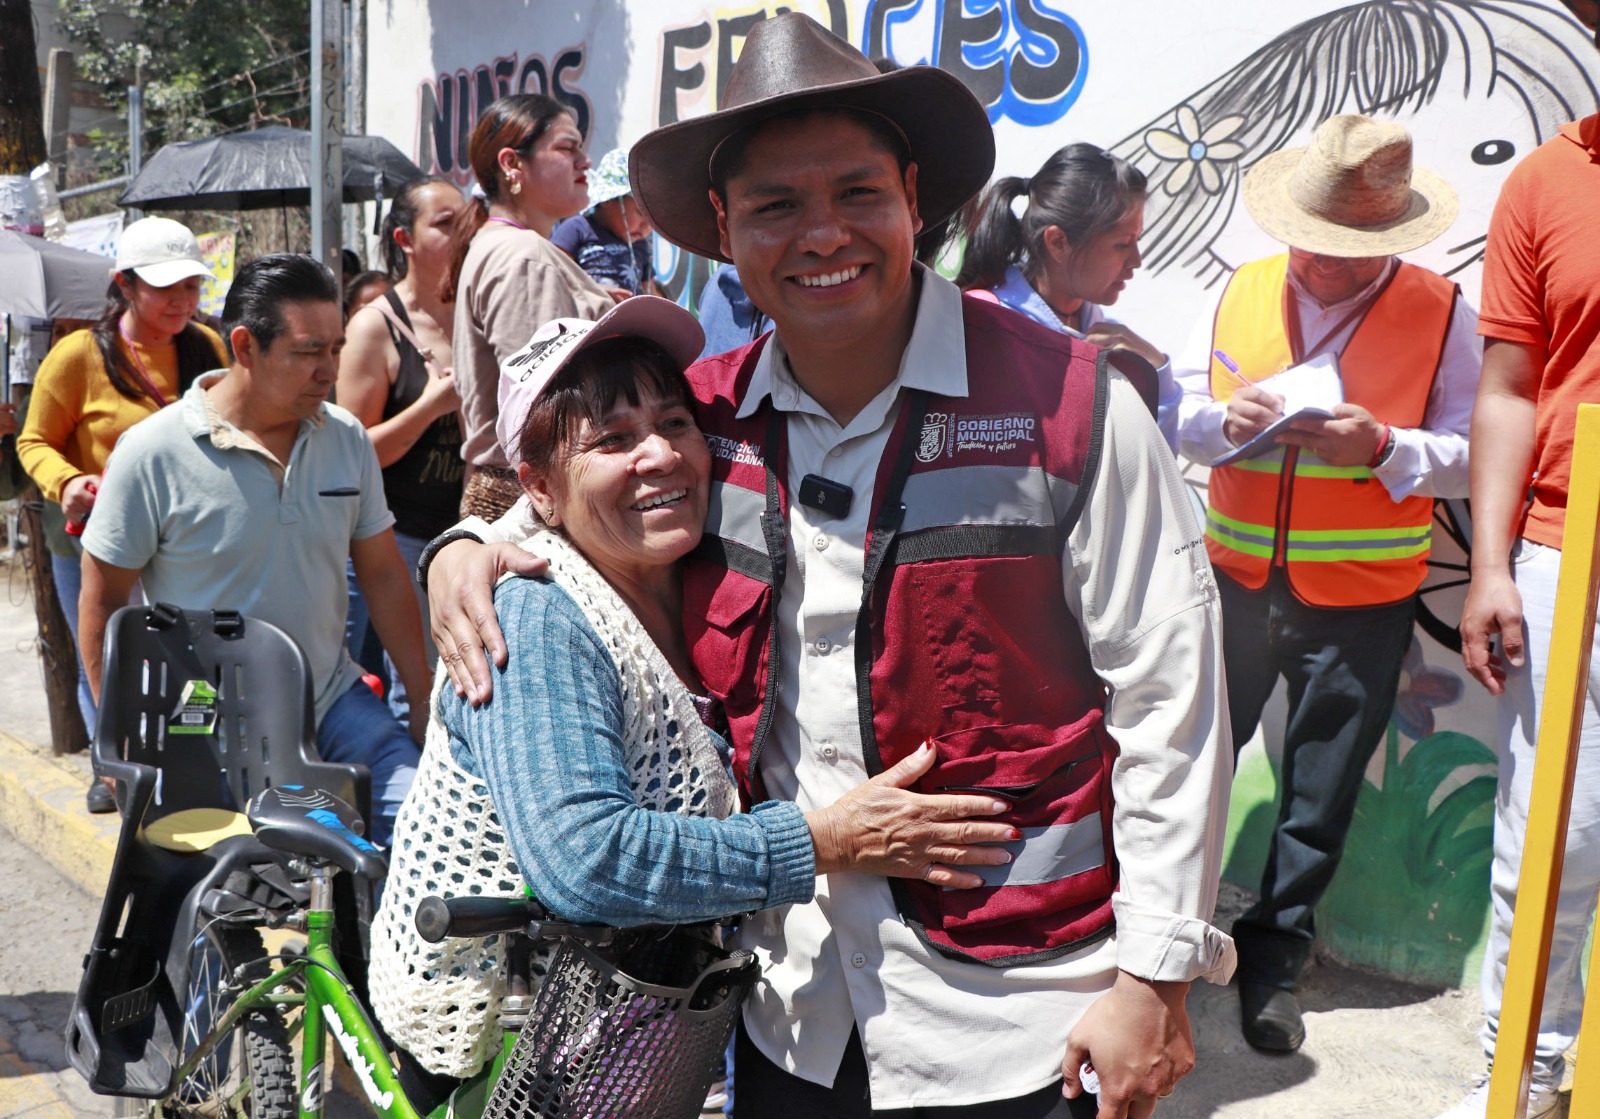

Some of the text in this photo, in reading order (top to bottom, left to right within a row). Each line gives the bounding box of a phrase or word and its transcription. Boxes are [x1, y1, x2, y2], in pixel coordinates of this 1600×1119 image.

[655, 0, 1089, 126] FECES
[519, 328, 588, 382] adidas
[957, 417, 1034, 431] GOBIERNO
[957, 430, 1034, 441] MUNICIPAL
[712, 436, 761, 455] ENCIÓN
[714, 447, 765, 467] UDADANA
